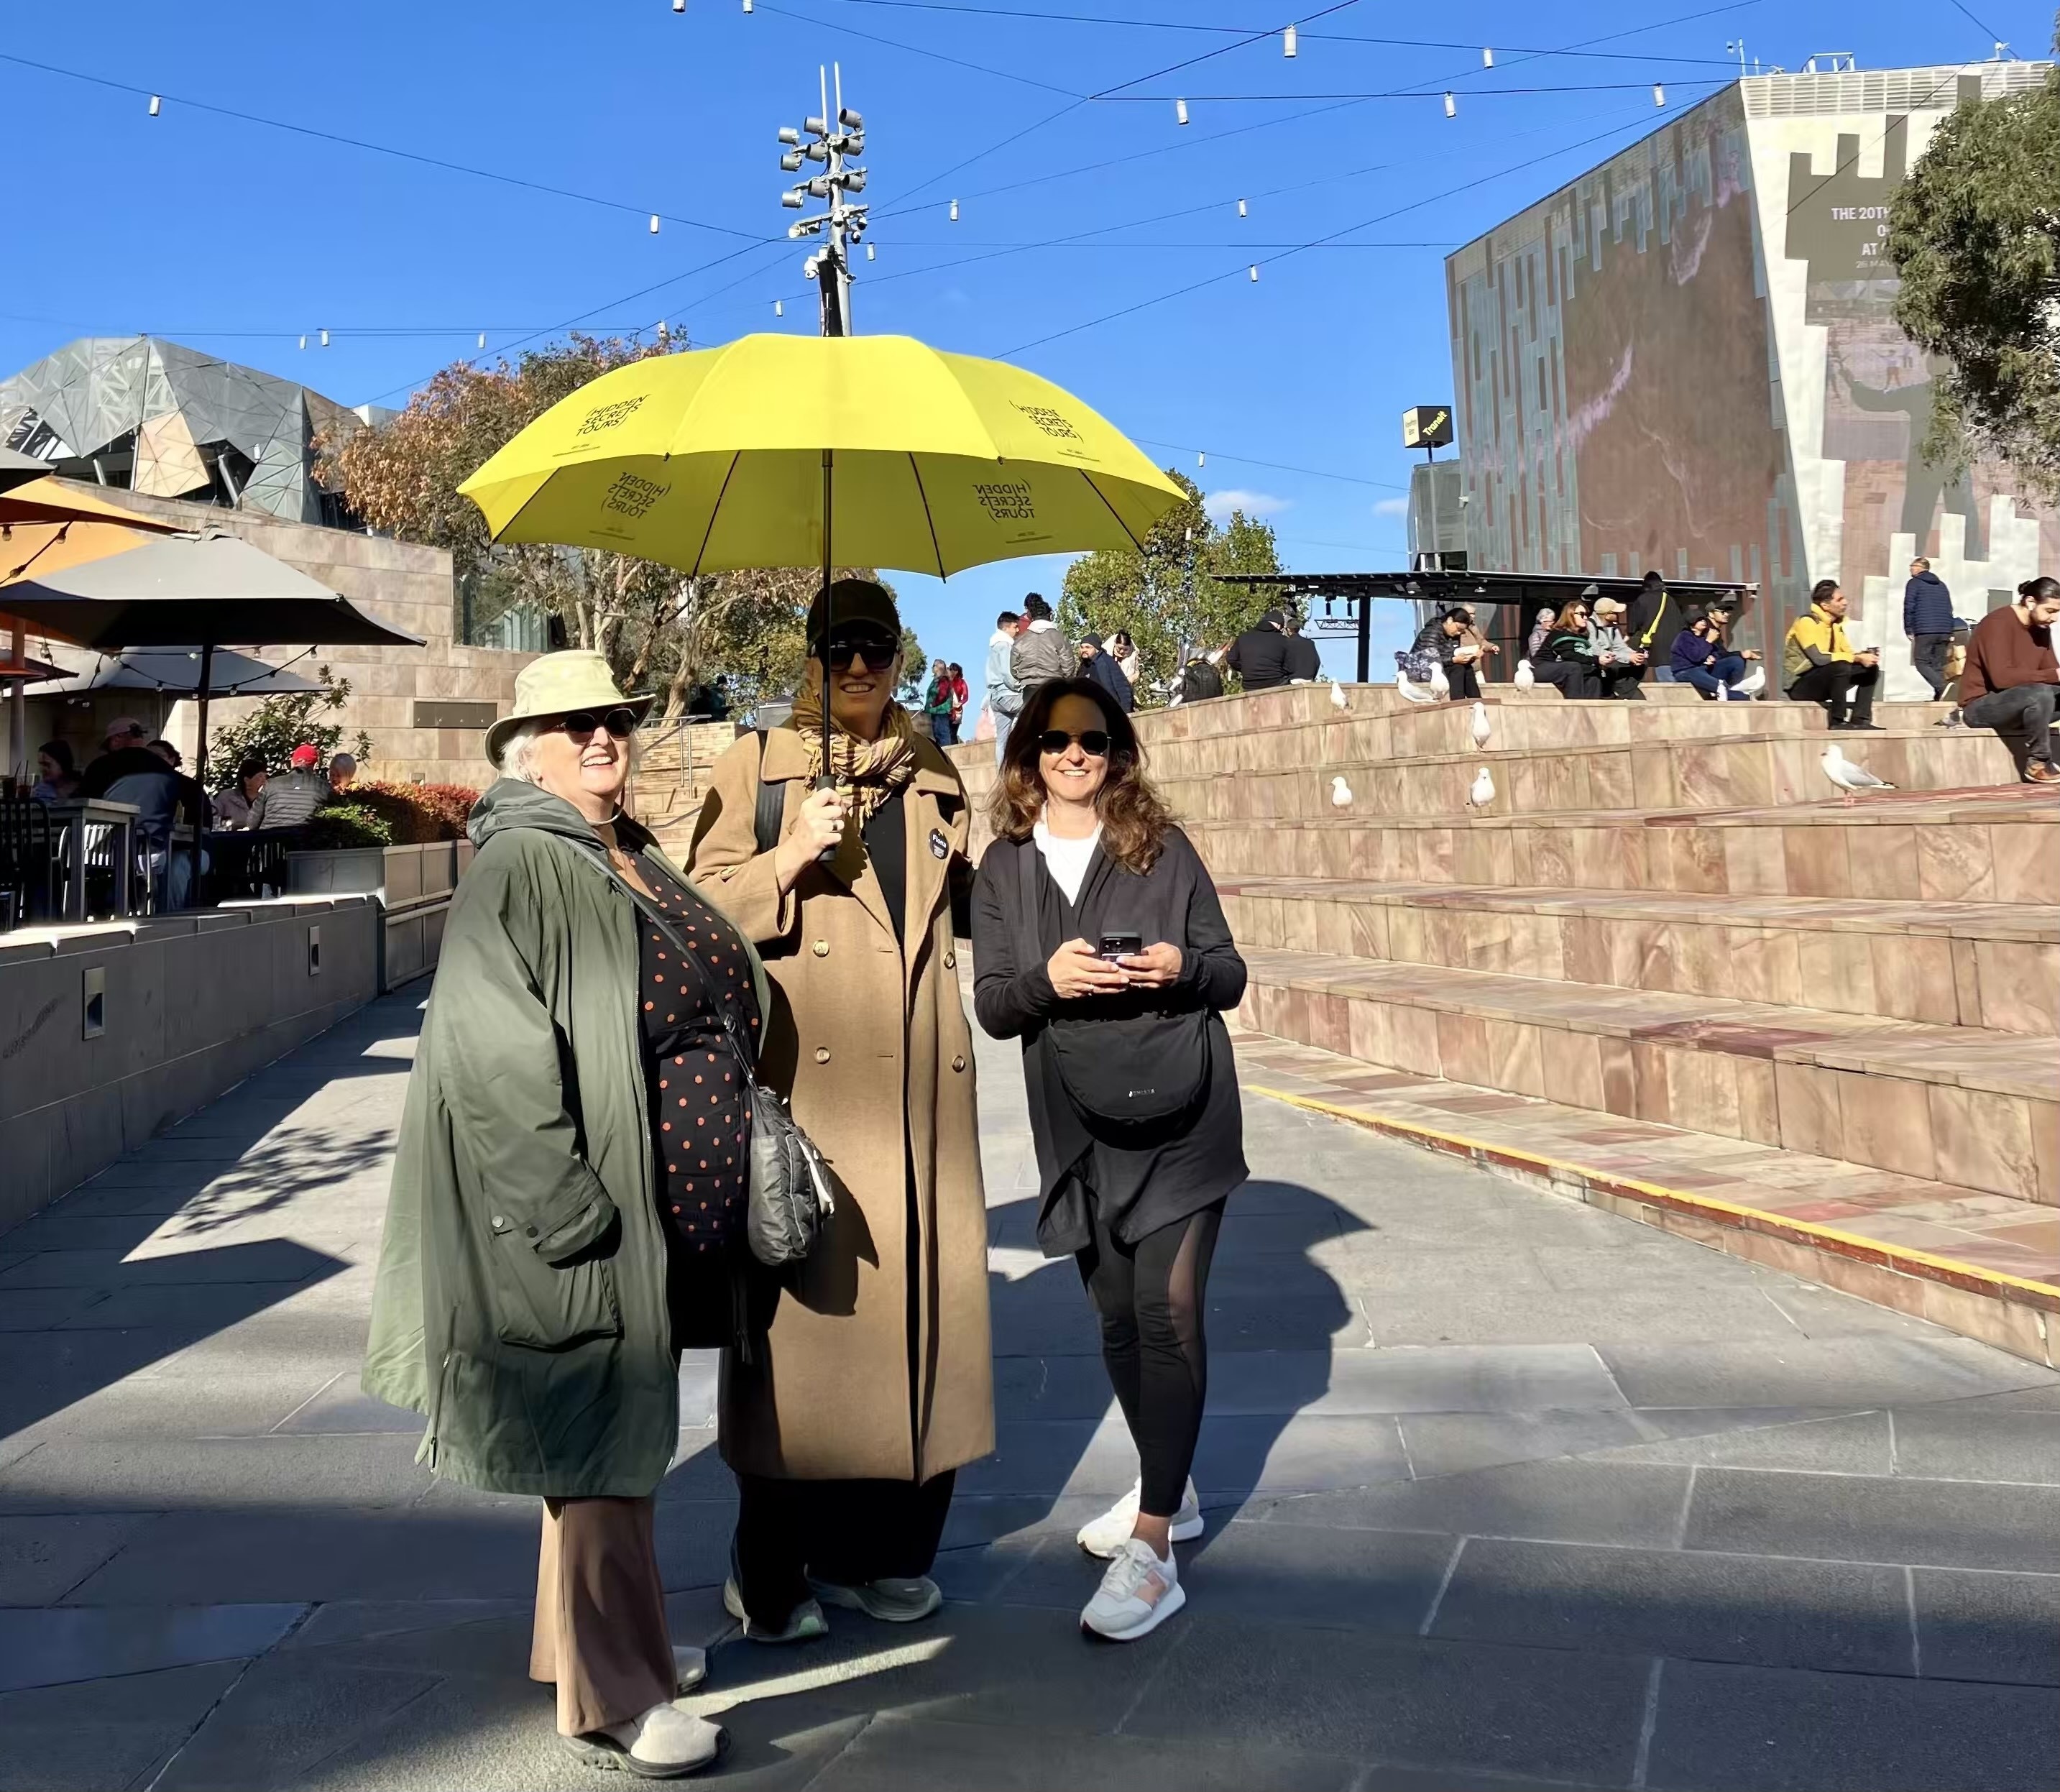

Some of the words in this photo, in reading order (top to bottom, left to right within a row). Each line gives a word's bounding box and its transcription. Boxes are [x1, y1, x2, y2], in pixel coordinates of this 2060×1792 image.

[1831, 207, 1857, 220] THE
[1862, 243, 1878, 256] AT
[581, 403, 642, 427] SECRETS
[1029, 415, 1073, 431] SECRETS
[1422, 410, 1448, 436] Transit
